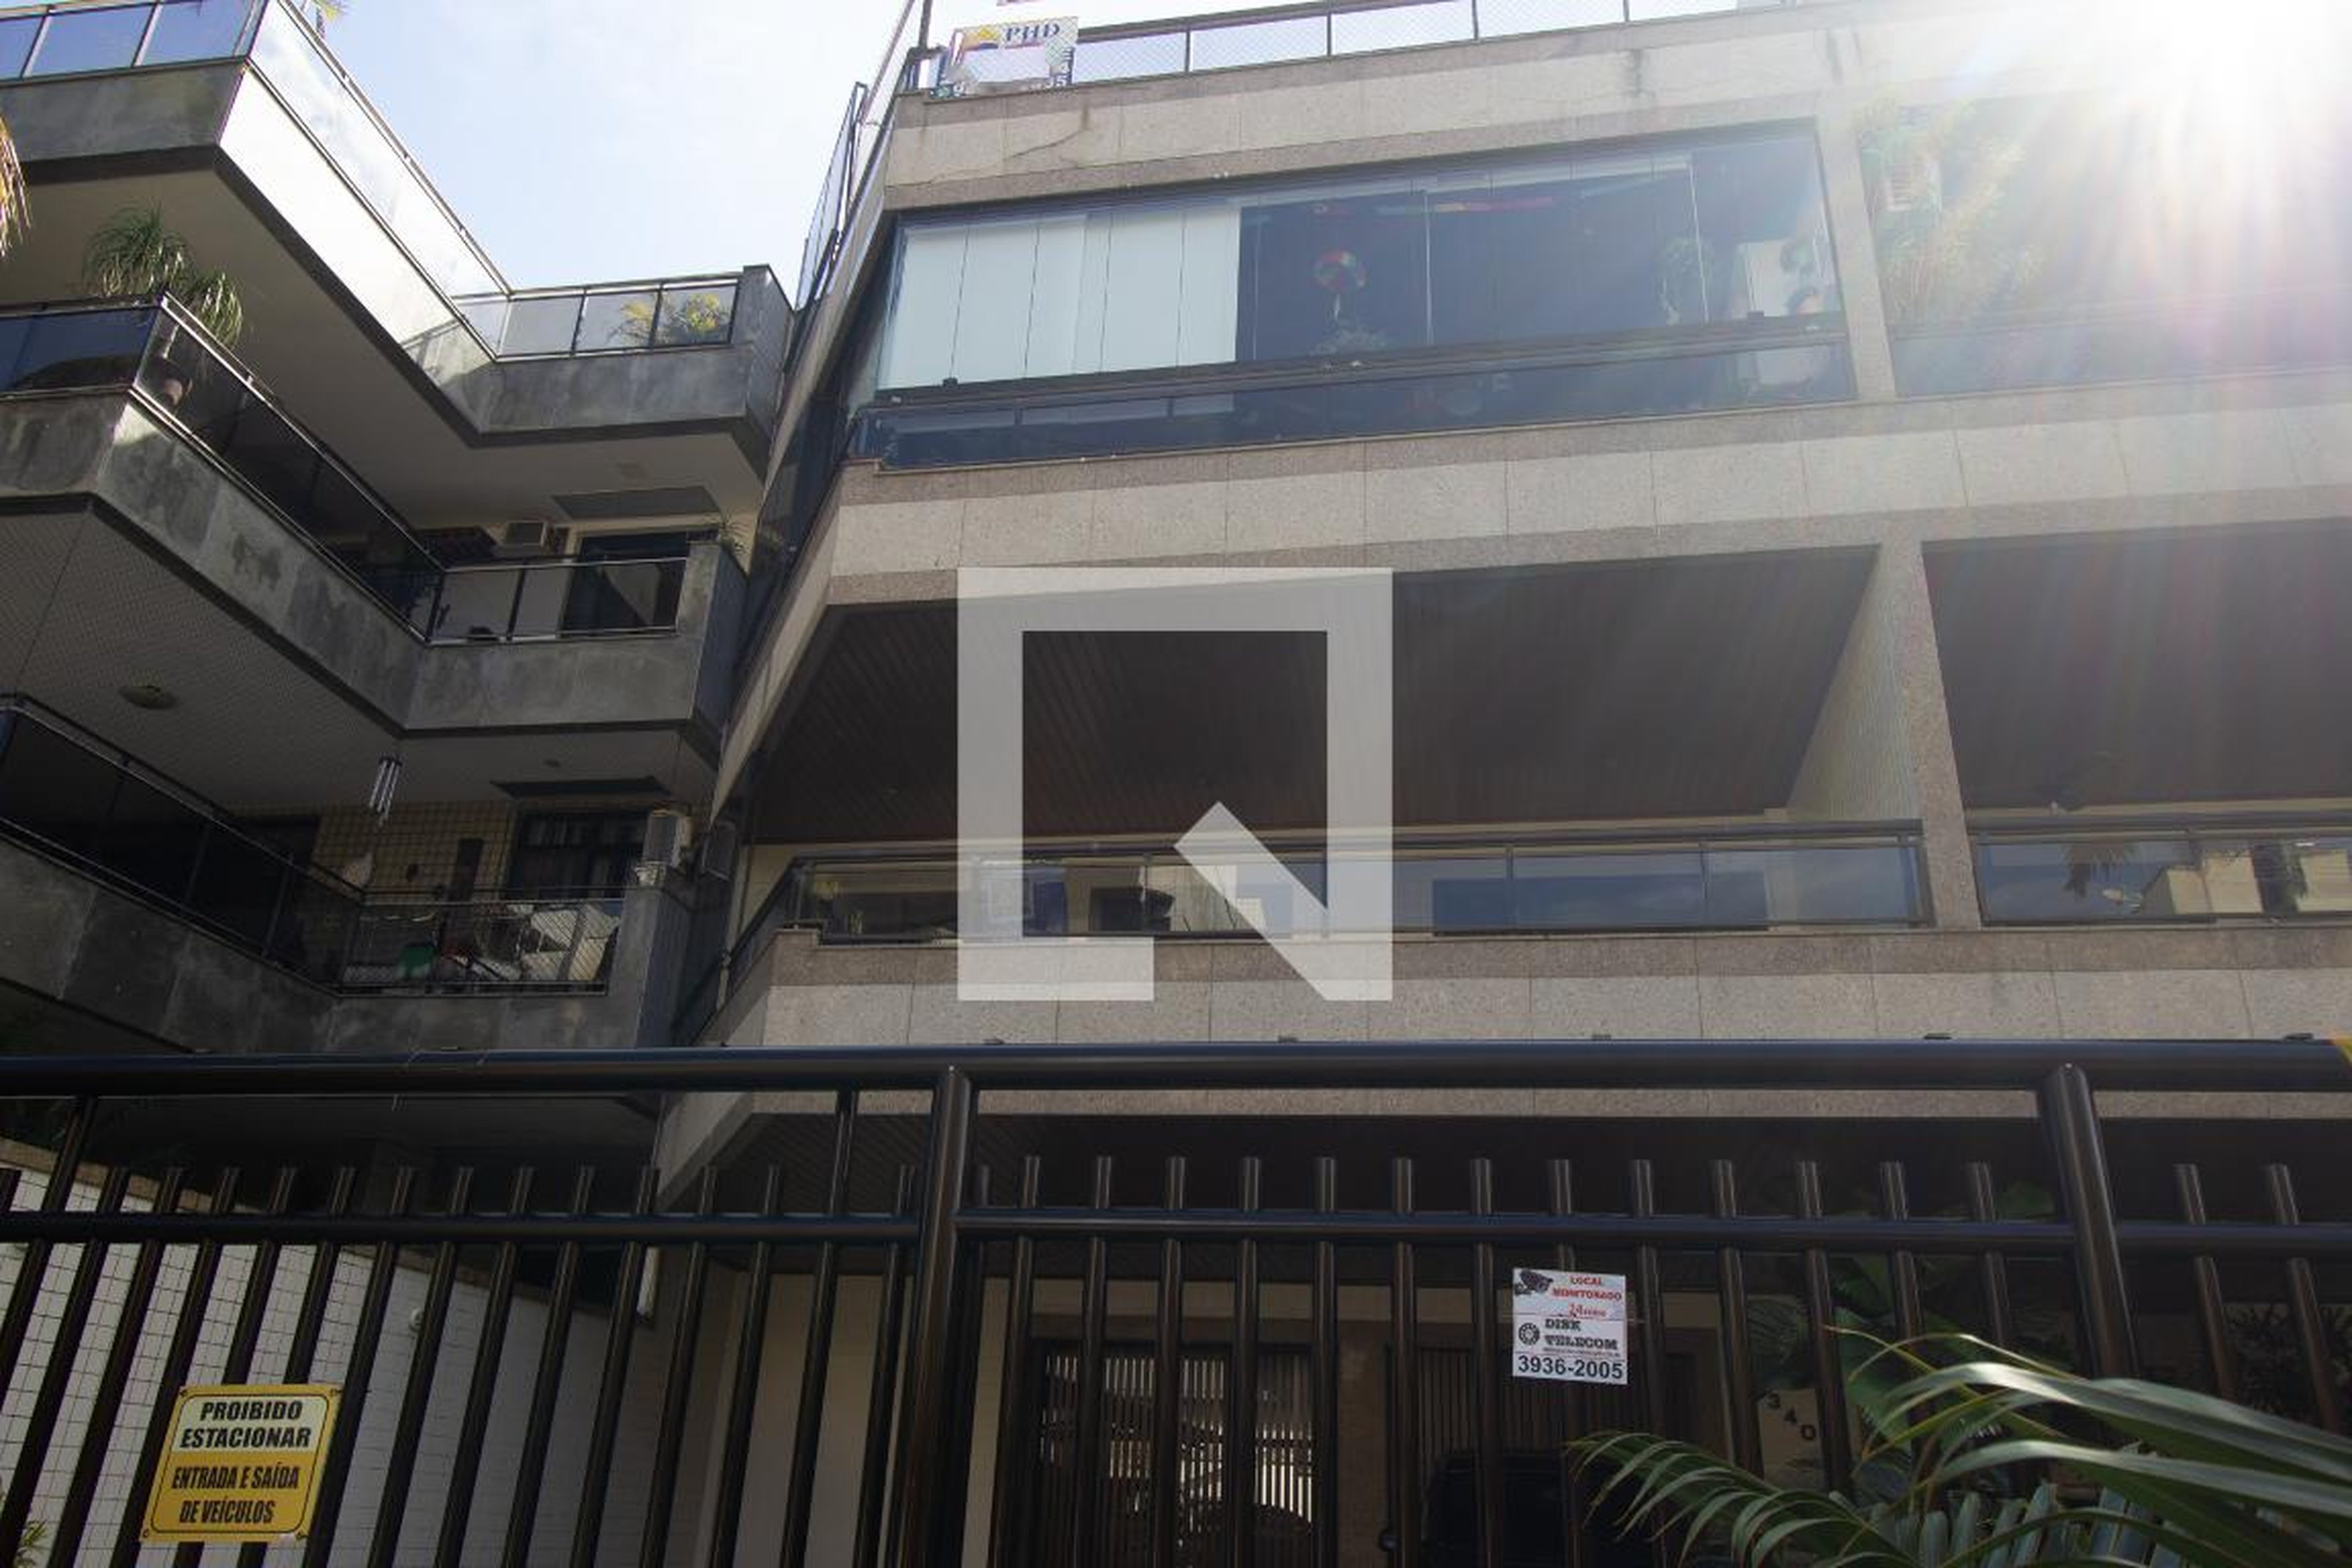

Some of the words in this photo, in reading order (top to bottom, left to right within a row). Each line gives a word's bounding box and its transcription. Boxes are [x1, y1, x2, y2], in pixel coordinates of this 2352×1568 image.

[1006, 23, 1060, 41] PHD
[1570, 1276, 1602, 1286] LOCAL
[1553, 1287, 1623, 1301] MONITORADO
[1545, 1318, 1581, 1332] DISK
[1544, 1334, 1619, 1350] TELECOM
[1518, 1355, 1623, 1379] 3936-2005
[200, 1401, 304, 1421] PROIBIDO
[179, 1427, 312, 1448] ESTACIONAR
[172, 1466, 238, 1489] ENTRADA
[239, 1467, 251, 1489] E
[251, 1462, 299, 1489] SAÍDA
[179, 1500, 199, 1523] DE
[201, 1496, 276, 1524] VEÍCULOS
